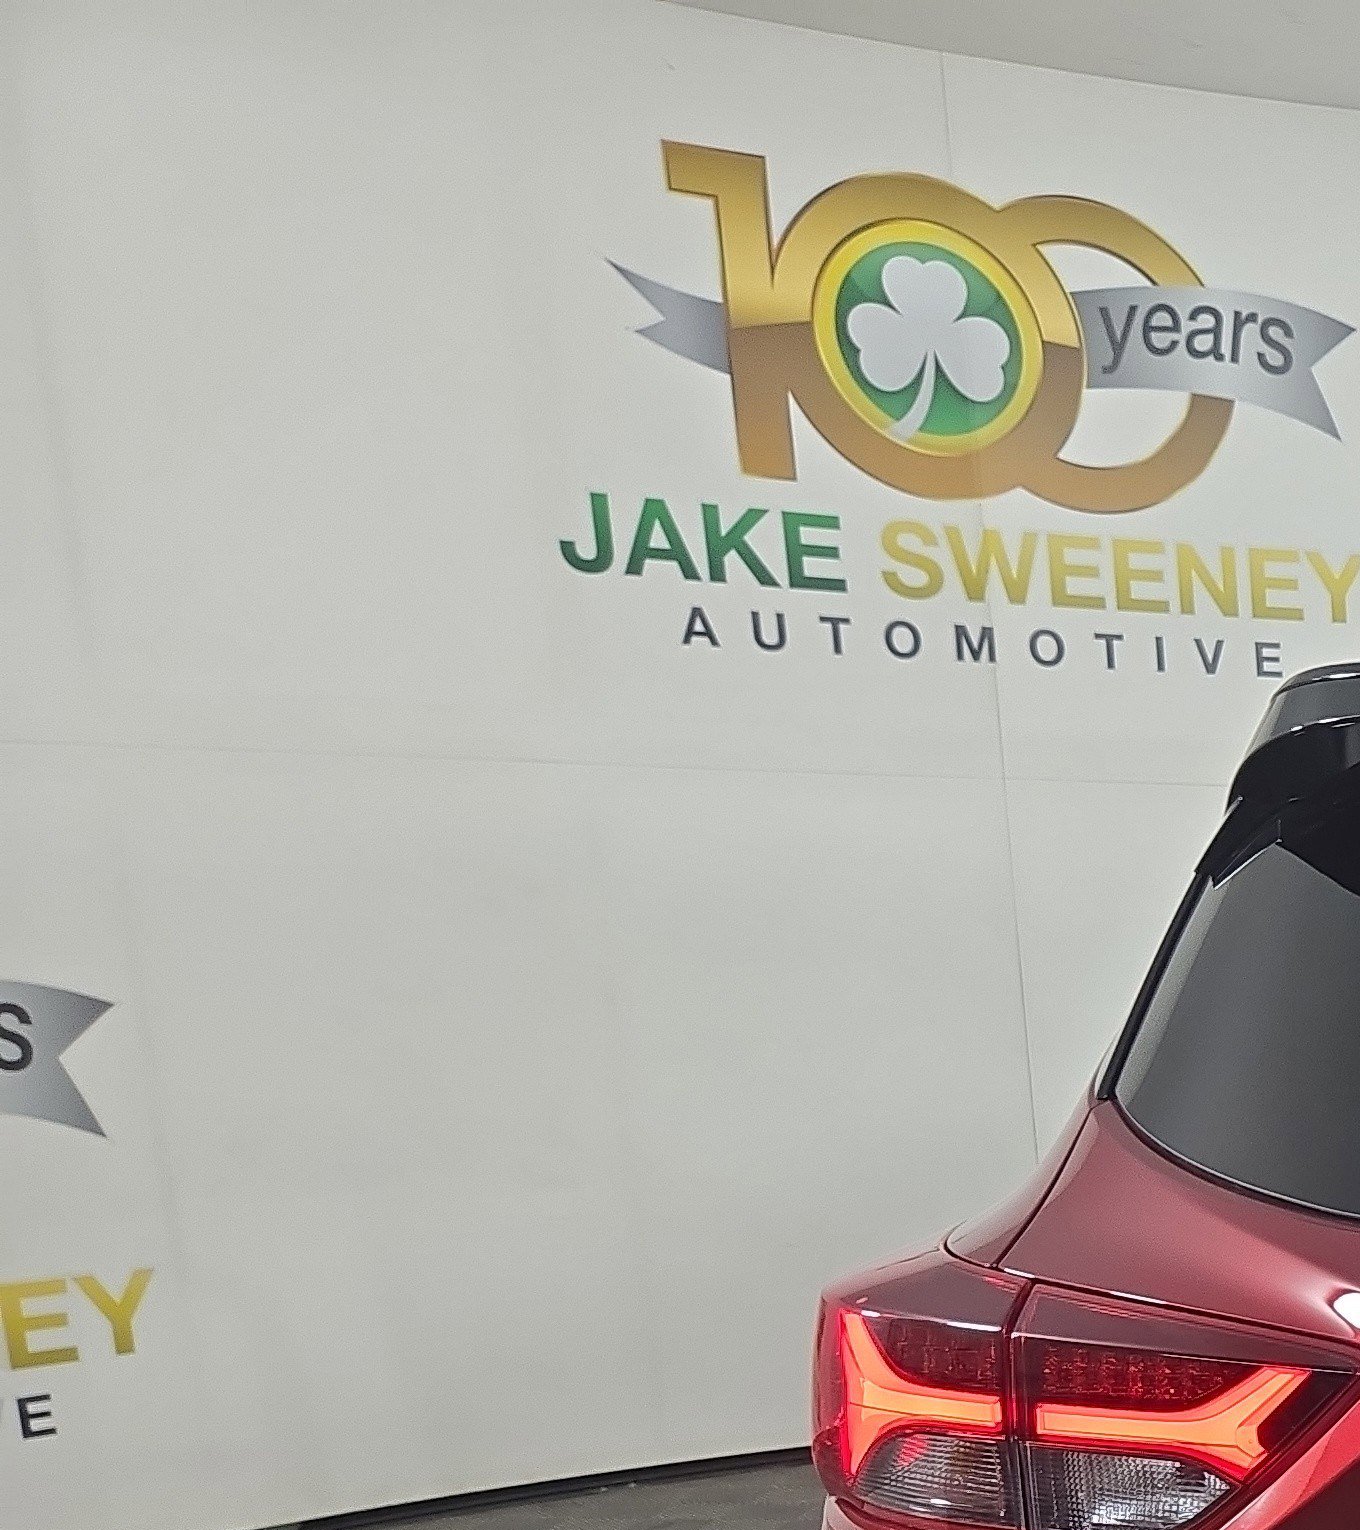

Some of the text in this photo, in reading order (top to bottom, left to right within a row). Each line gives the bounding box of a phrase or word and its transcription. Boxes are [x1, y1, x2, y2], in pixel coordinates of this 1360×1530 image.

[662, 139, 1296, 514] 100 years
[559, 492, 848, 592] JAKE
[681, 606, 1284, 678] AUTOMOTIVE
